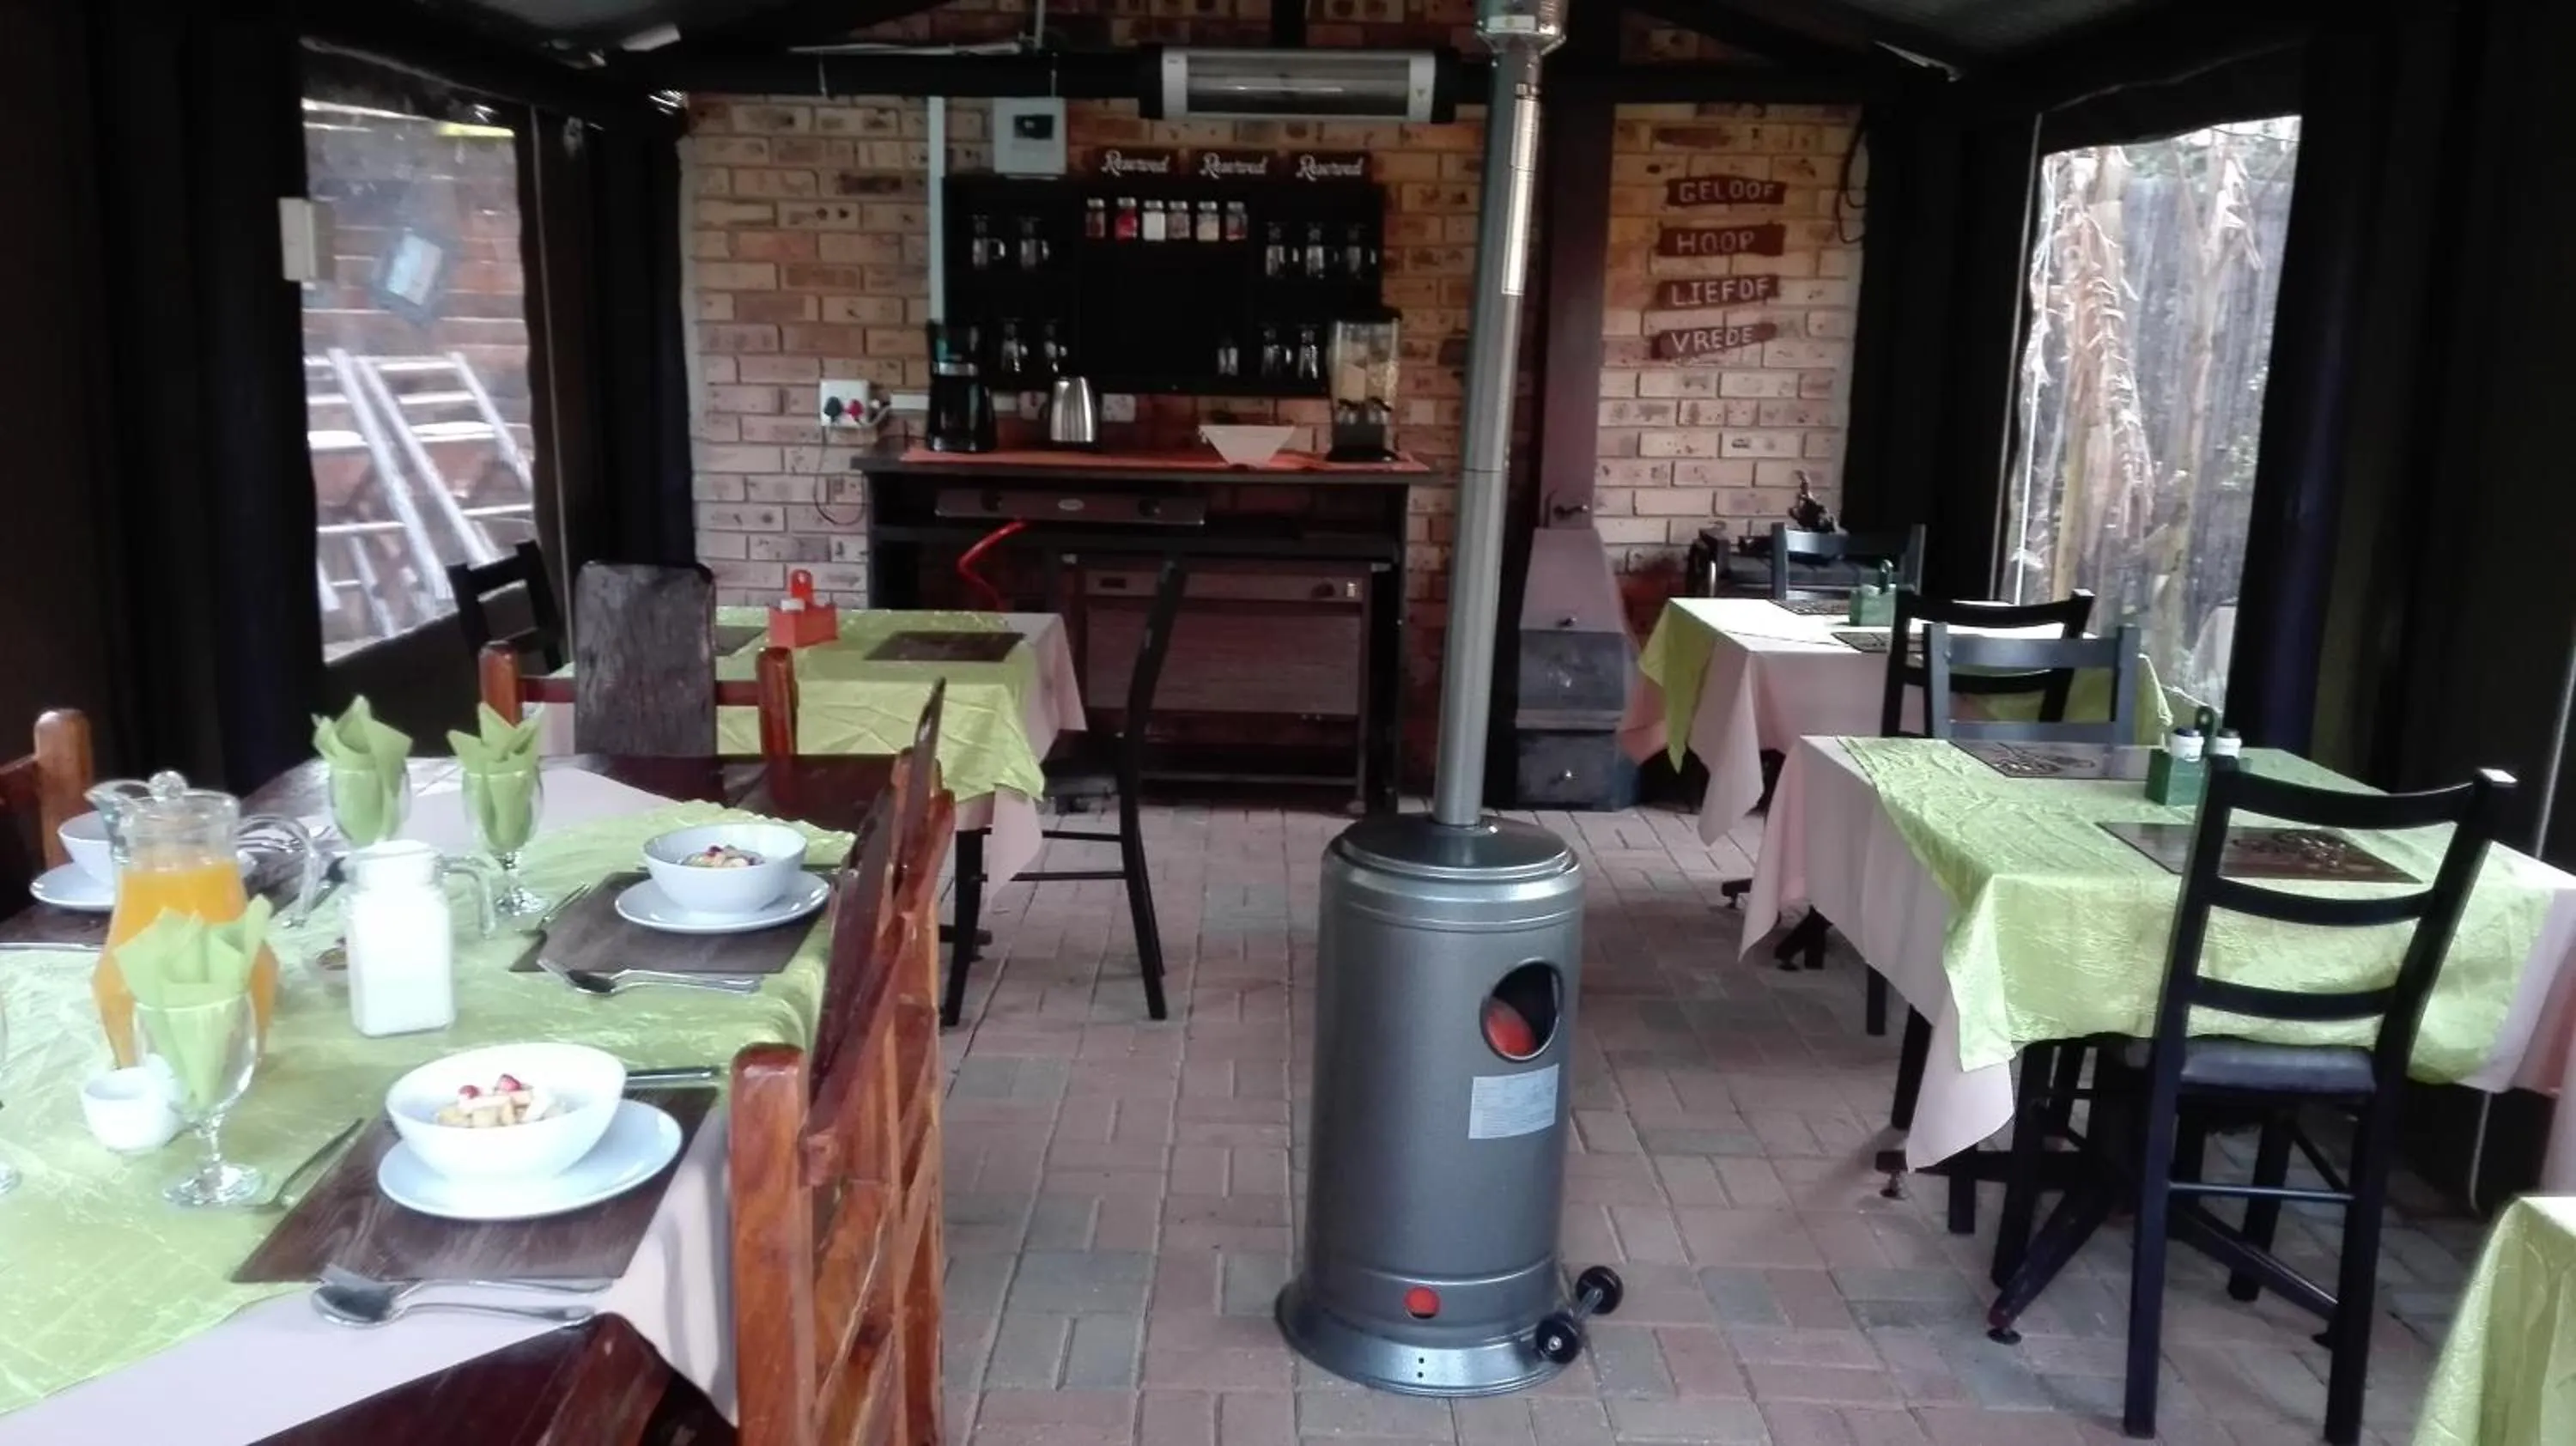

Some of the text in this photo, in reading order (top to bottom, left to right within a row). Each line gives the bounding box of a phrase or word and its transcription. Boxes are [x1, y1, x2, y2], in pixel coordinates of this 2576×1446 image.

[1102, 150, 1170, 177] Reserved
[1200, 153, 1267, 179] Reserved
[1297, 155, 1363, 181] Reserved
[1679, 180, 1775, 203] GELOOF
[1677, 231, 1754, 254] HOOP
[1672, 328, 1753, 353] VREDE
